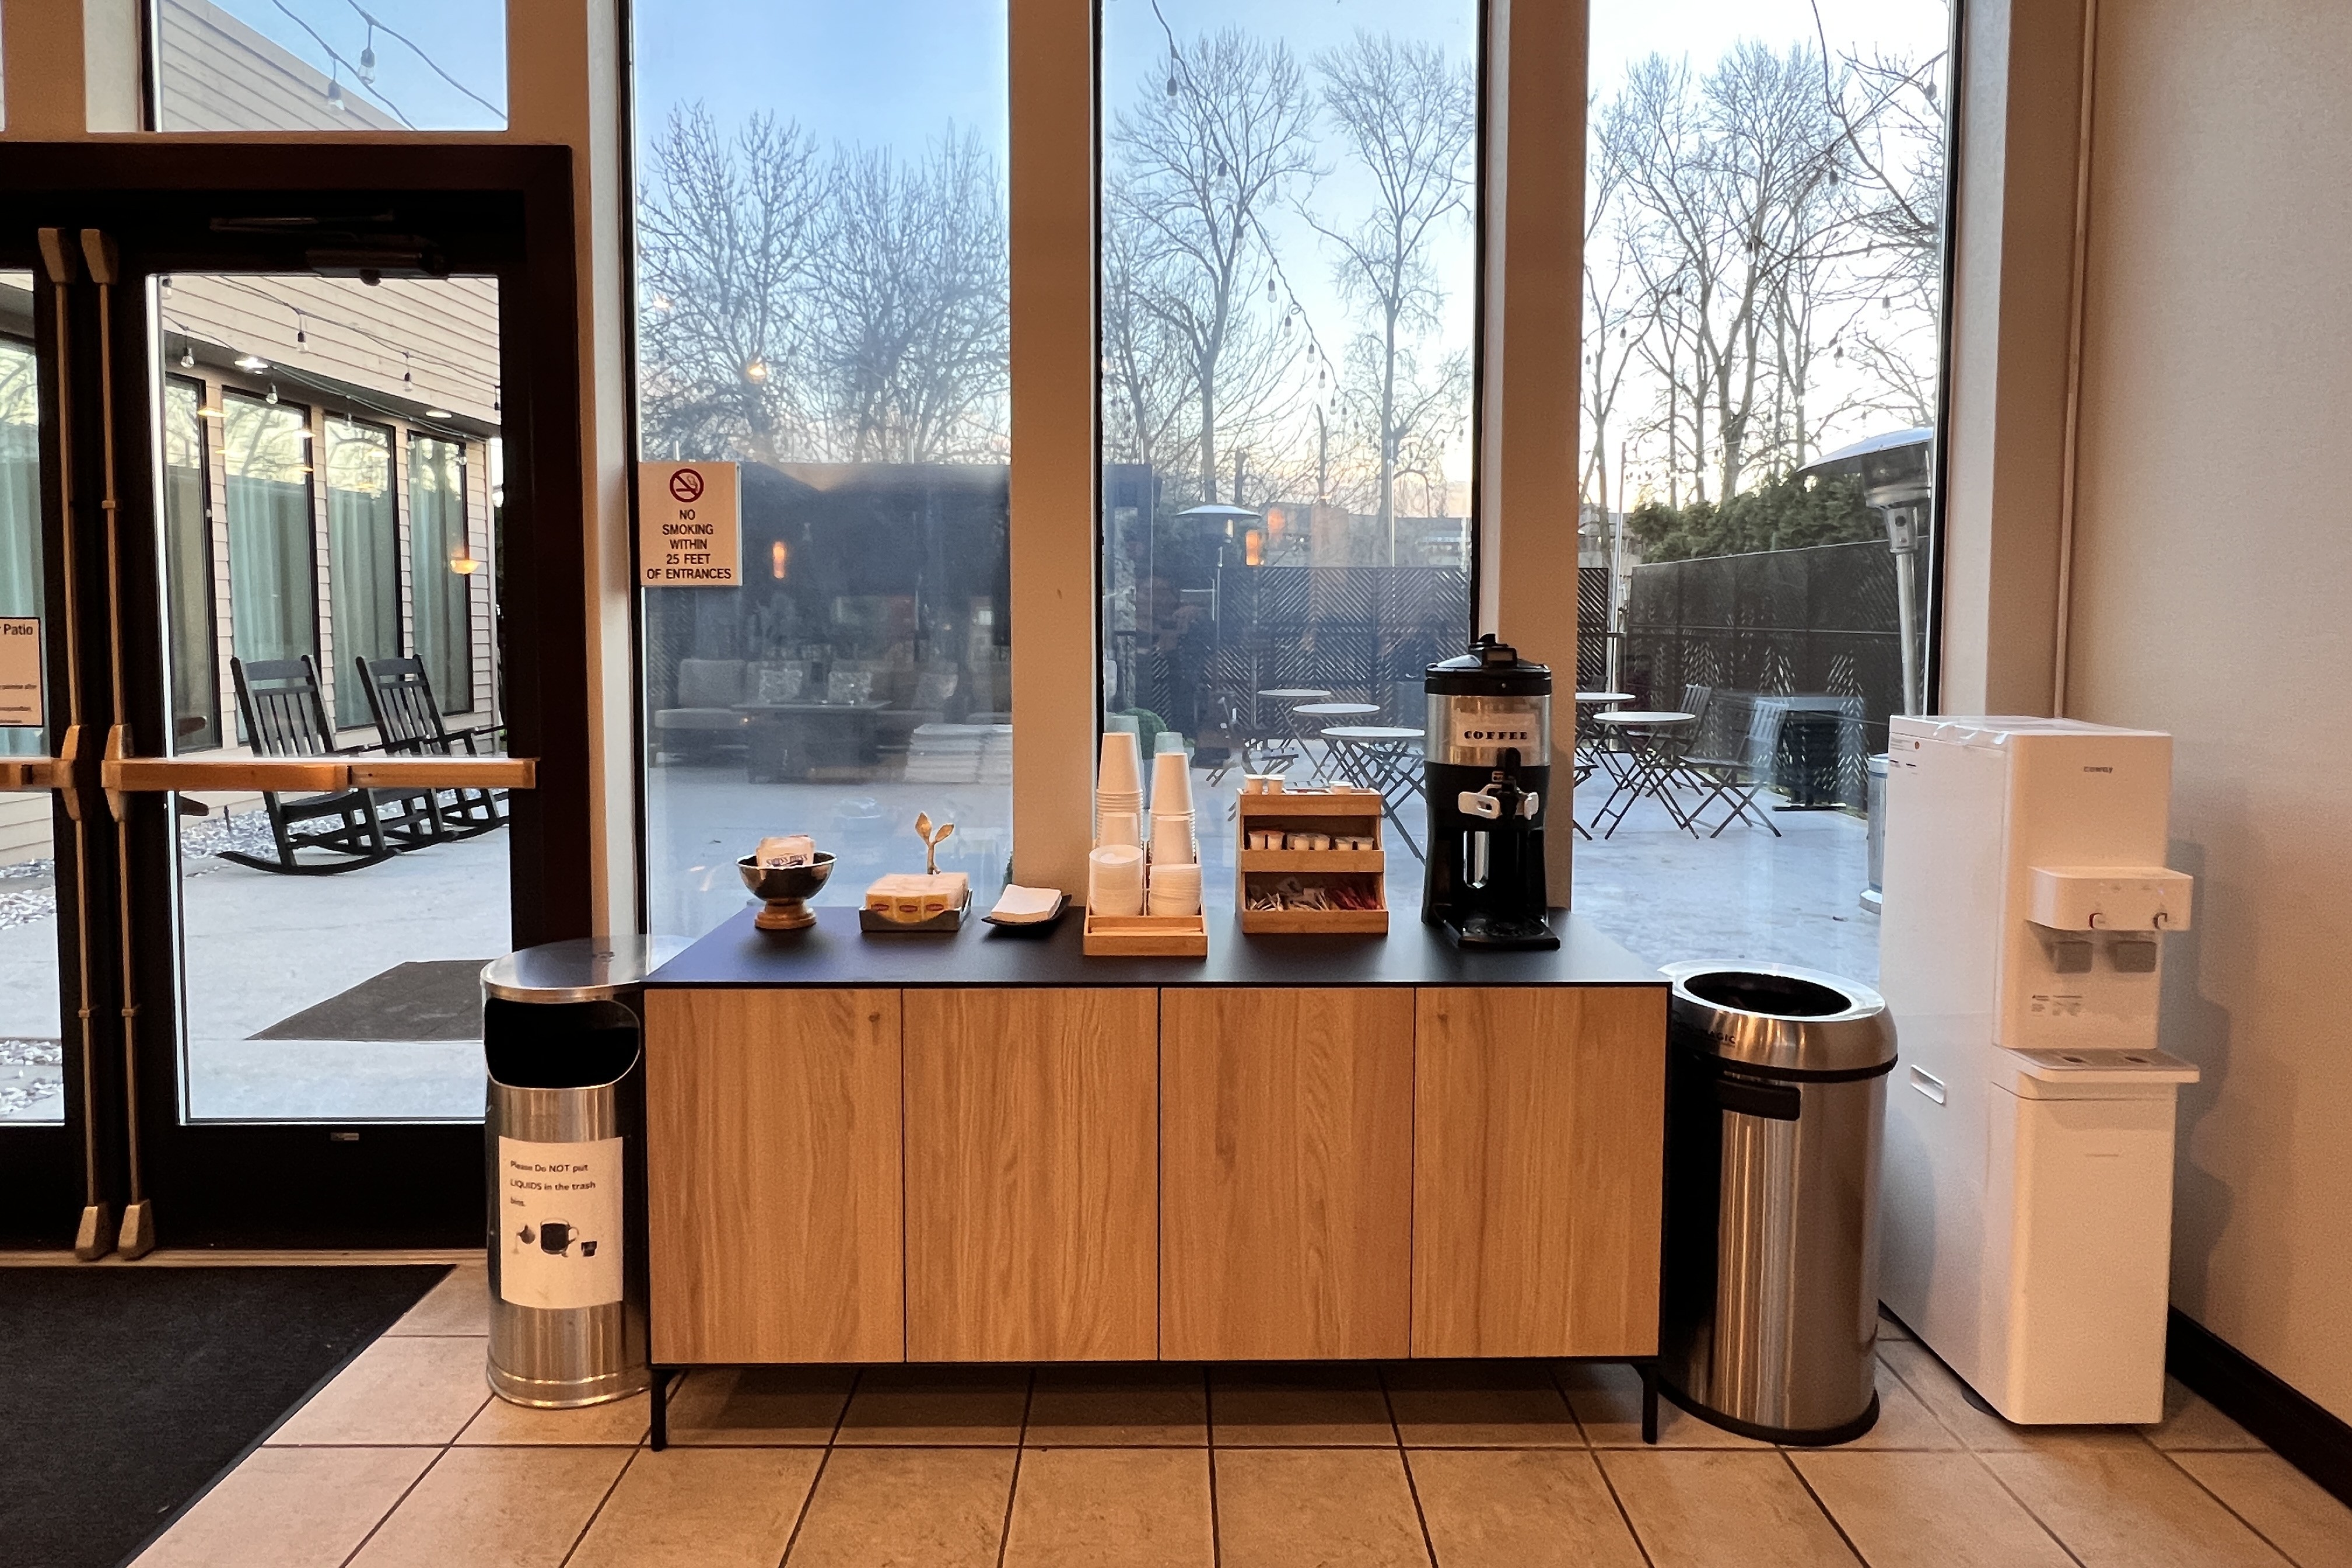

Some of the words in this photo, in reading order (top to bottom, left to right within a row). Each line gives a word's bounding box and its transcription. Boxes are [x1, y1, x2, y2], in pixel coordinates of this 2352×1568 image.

[679, 509, 695, 520] NO
[662, 524, 714, 536] SMOKING
[670, 538, 708, 550] WITHIN
[666, 554, 680, 565] 25
[684, 554, 711, 565] FEET
[647, 568, 662, 579] OF
[666, 568, 732, 579] ENTRANCES
[4, 623, 33, 636] Patio
[1464, 730, 1527, 740] COFFEE
[510, 1160, 533, 1171] Please
[534, 1164, 547, 1172] Do
[548, 1164, 570, 1172] NOT
[572, 1164, 588, 1173] put
[510, 1178, 542, 1190] LIQUIDS
[555, 1182, 569, 1191] the
[572, 1181, 596, 1191] trash
